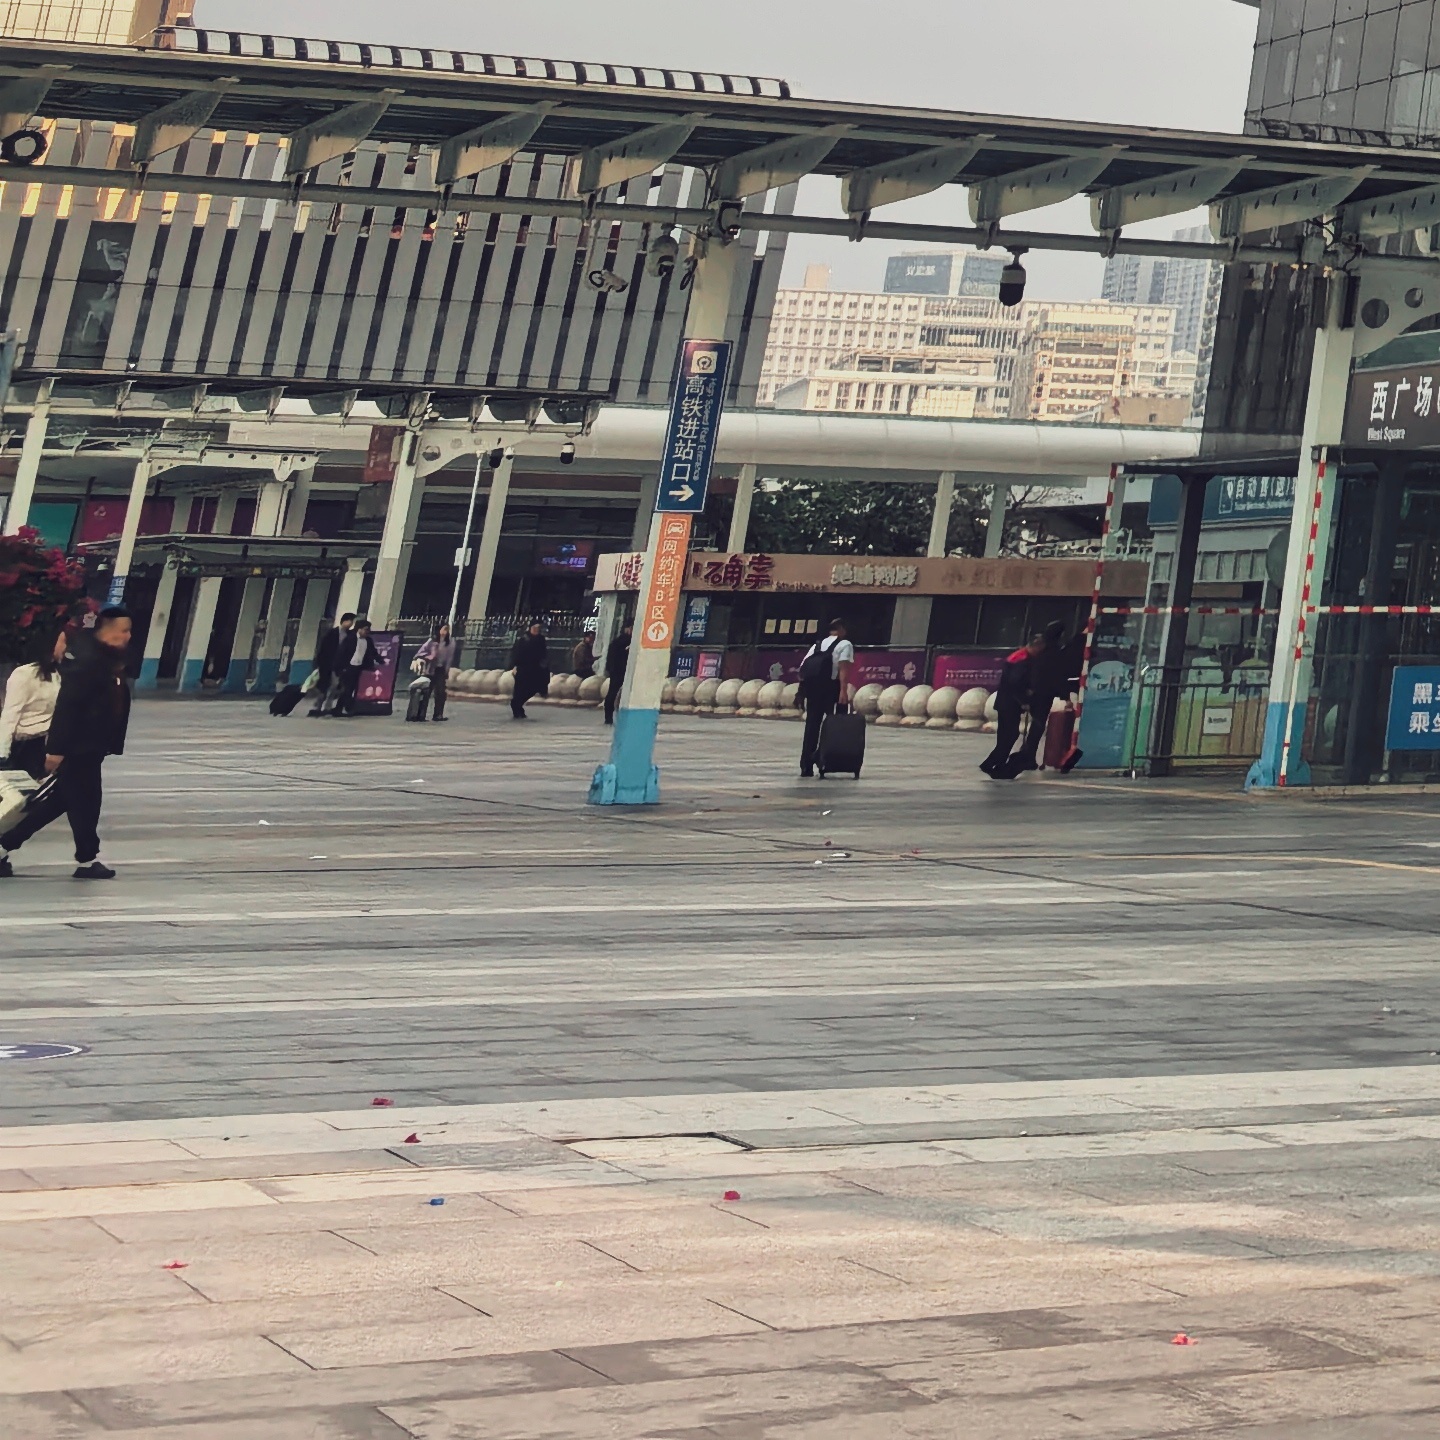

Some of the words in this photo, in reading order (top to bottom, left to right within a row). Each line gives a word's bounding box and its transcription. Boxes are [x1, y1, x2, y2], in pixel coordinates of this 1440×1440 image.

[669, 375, 706, 482] 高铁进站口
[651, 540, 677, 620] 网约车B区
